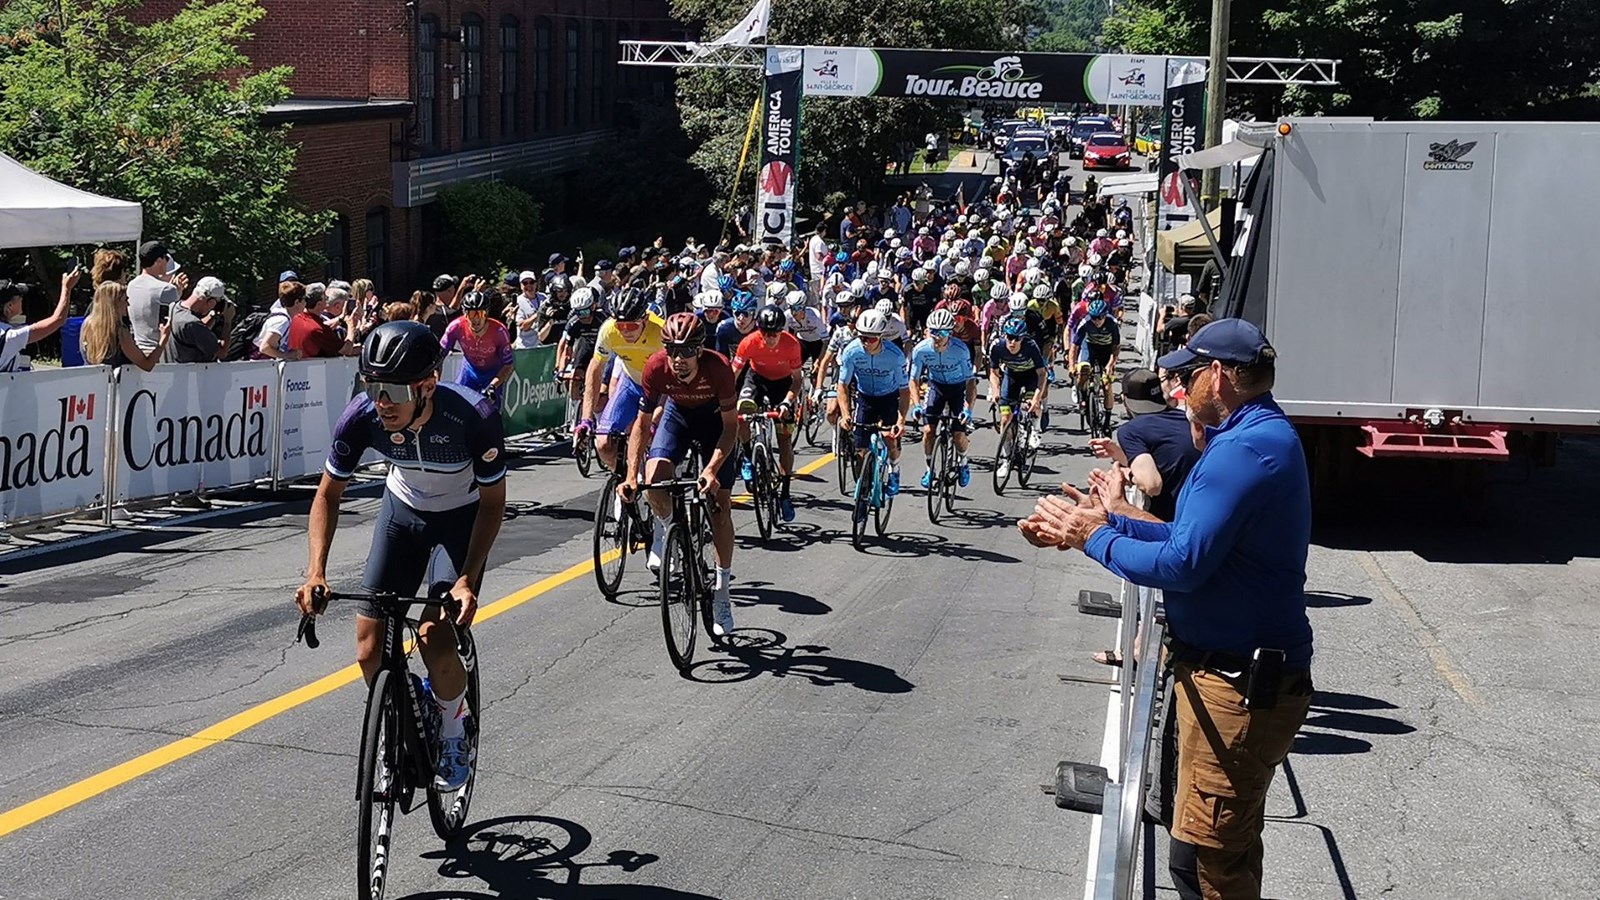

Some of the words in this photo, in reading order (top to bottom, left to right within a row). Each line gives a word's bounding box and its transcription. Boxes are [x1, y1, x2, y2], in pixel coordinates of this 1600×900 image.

[904, 74, 954, 96] Tour
[948, 87, 959, 96] de
[959, 76, 1043, 99] Beauce
[767, 90, 782, 155] AMERICA
[779, 118, 793, 156] TOUR
[1169, 97, 1185, 163] AMERICA
[1182, 125, 1196, 156] OUR
[123, 386, 267, 471] Canada
[385, 616, 395, 658] GIANT
